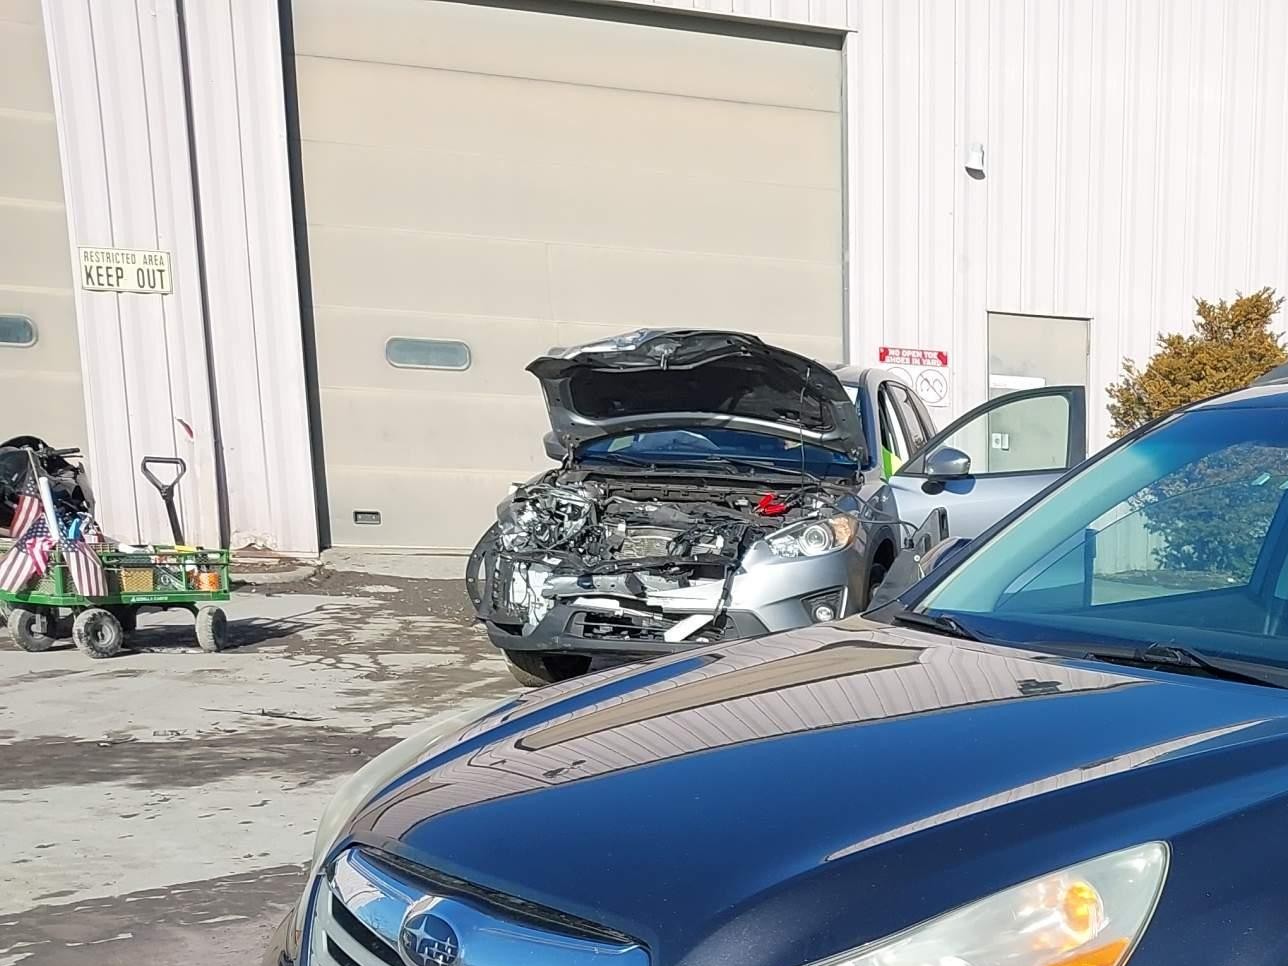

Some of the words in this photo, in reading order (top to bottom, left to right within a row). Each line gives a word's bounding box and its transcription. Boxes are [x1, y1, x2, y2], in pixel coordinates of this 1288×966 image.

[84, 251, 136, 264] RESTRICTED
[143, 254, 165, 266] AREA
[84, 265, 124, 287] KEEP
[136, 268, 166, 289] OUT
[901, 350, 922, 358] OPEN
[885, 356, 911, 364] SHOES
